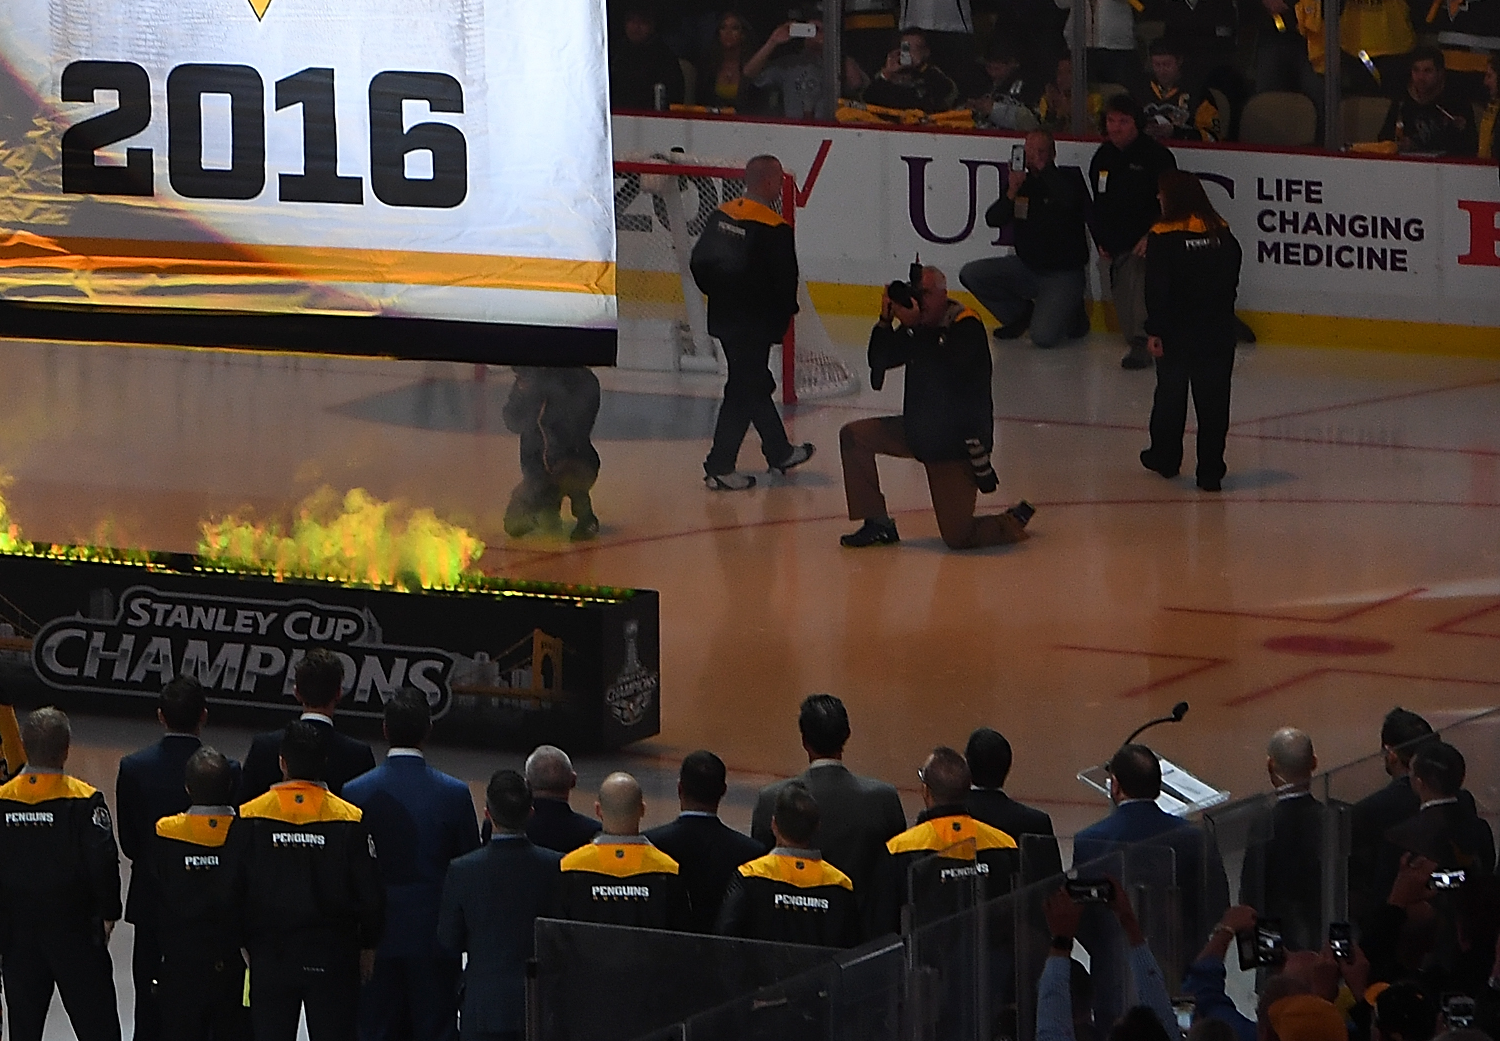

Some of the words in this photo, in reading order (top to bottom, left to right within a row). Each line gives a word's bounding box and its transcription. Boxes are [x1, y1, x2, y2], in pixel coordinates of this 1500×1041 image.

[60, 60, 467, 209] 2016
[1256, 177, 1324, 203] LIFE
[1256, 209, 1426, 242] CHANGING
[1256, 242, 1409, 273] MEDICINE
[125, 596, 281, 637] STANLEY
[282, 610, 361, 643] CUP
[4, 810, 54, 824] PENGUINS
[271, 832, 326, 846] PENGUINS
[591, 884, 650, 899] PENGUINS
[773, 893, 830, 910] PENGUINS
